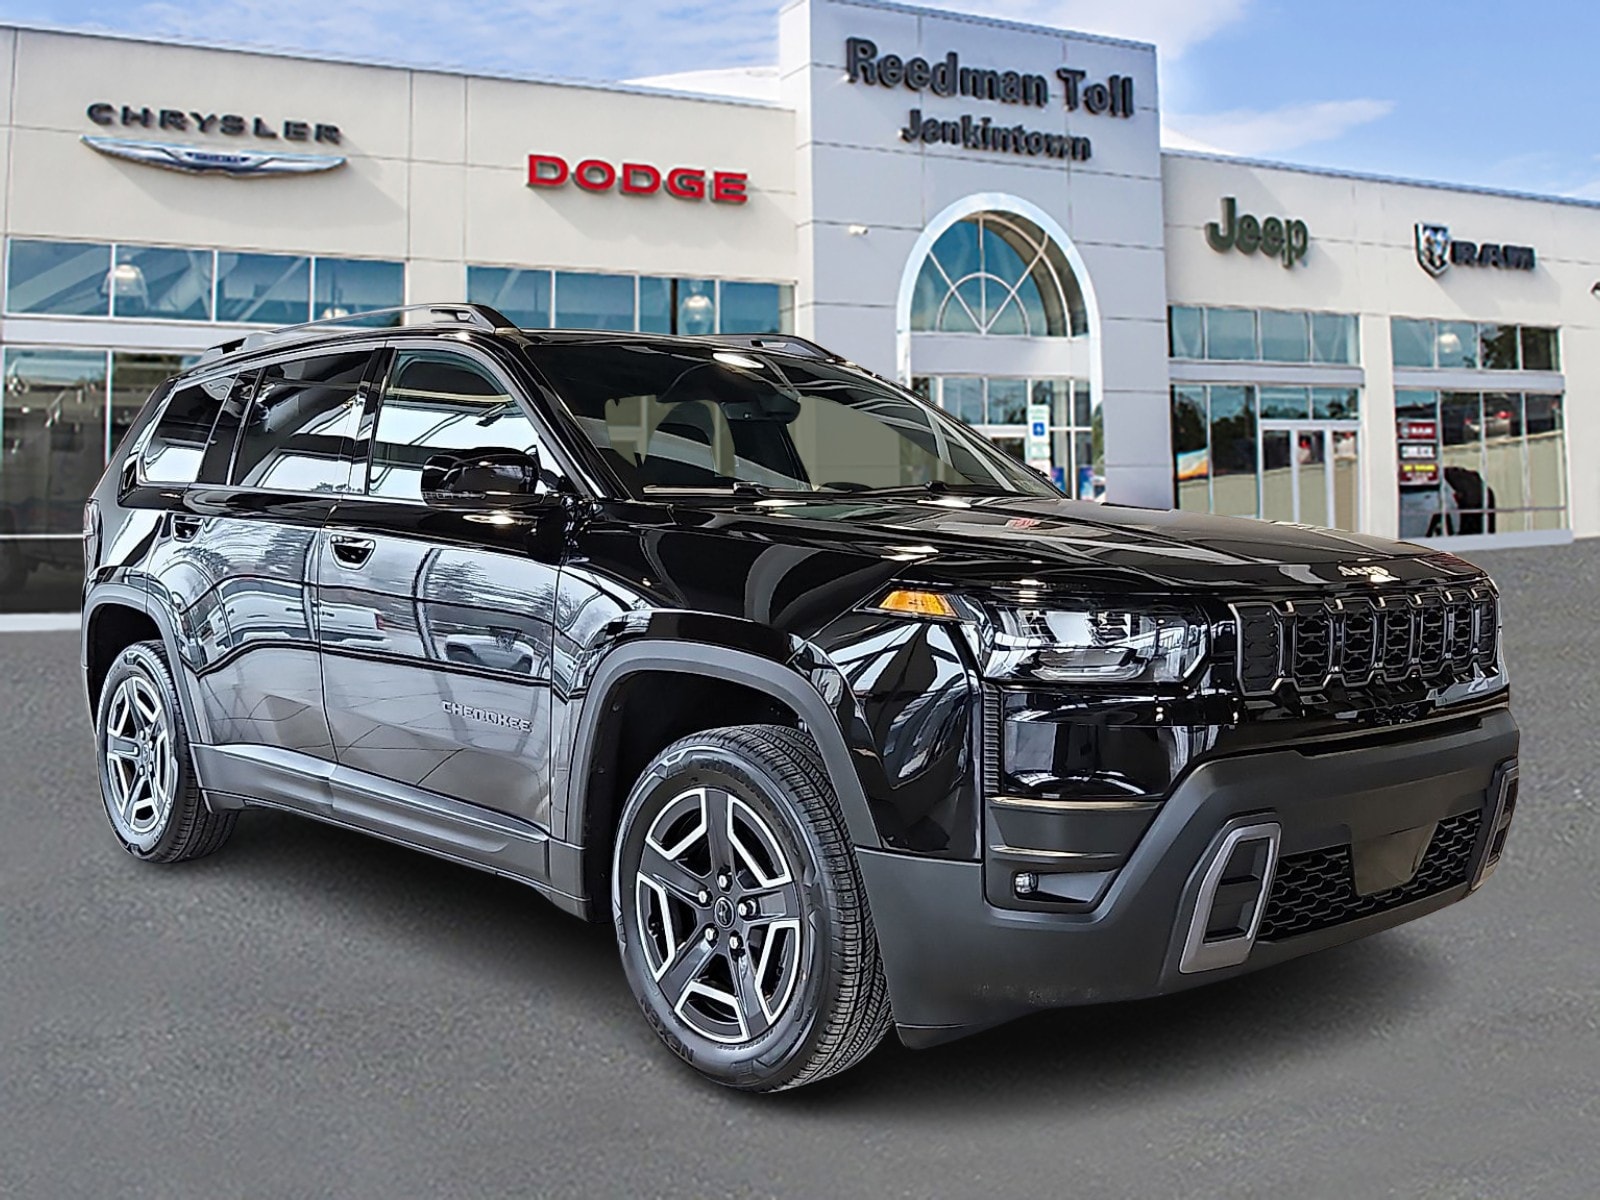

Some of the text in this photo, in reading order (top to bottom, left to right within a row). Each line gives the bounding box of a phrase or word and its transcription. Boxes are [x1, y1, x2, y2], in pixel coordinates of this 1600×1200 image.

[845, 37, 1135, 119] Reedman Toll
[86, 102, 342, 145] CHRYSLER
[901, 108, 1092, 161] Jenkintown
[526, 153, 749, 204] DODGE
[1205, 197, 1309, 270] Jeep
[1449, 240, 1537, 271] RAM
[441, 699, 533, 734] CHEROKEE
